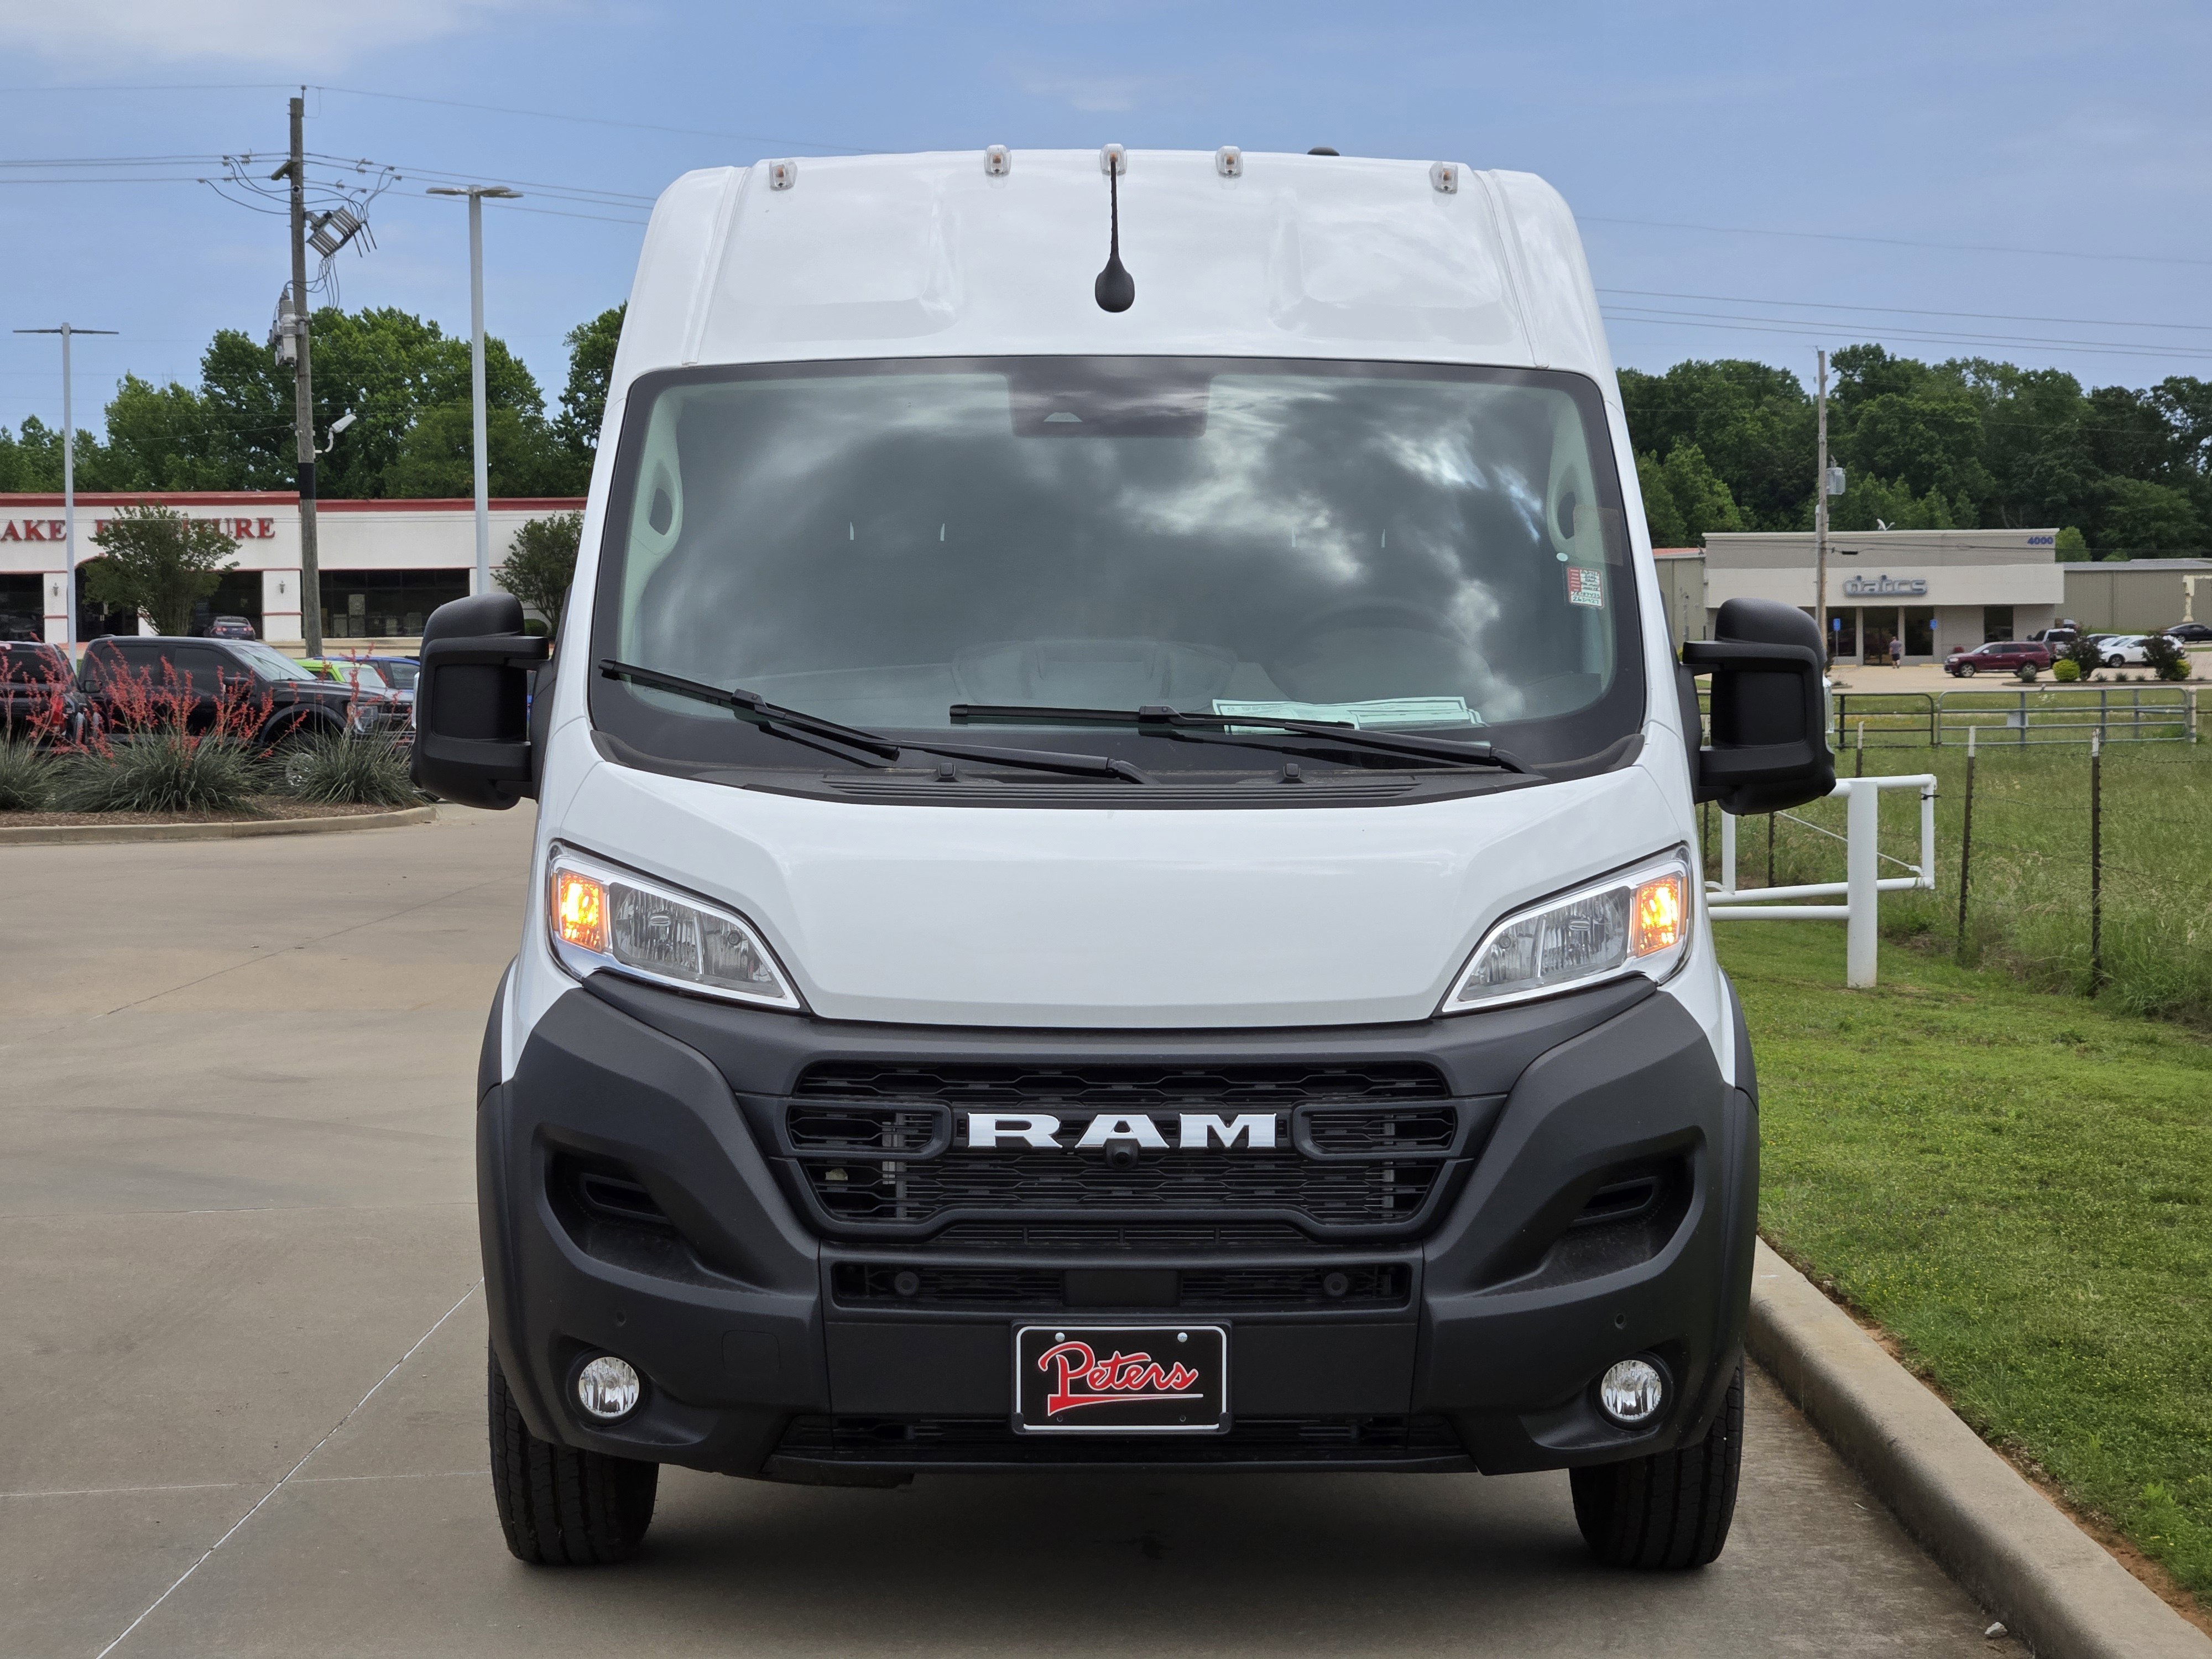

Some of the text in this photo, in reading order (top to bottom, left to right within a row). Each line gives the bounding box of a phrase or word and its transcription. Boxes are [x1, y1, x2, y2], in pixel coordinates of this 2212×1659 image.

[0, 518, 275, 541] AKE FITURE
[2027, 536, 2053, 545] 4000
[968, 1113, 1277, 1148] RAM
[1038, 1341, 1201, 1407] Peters
